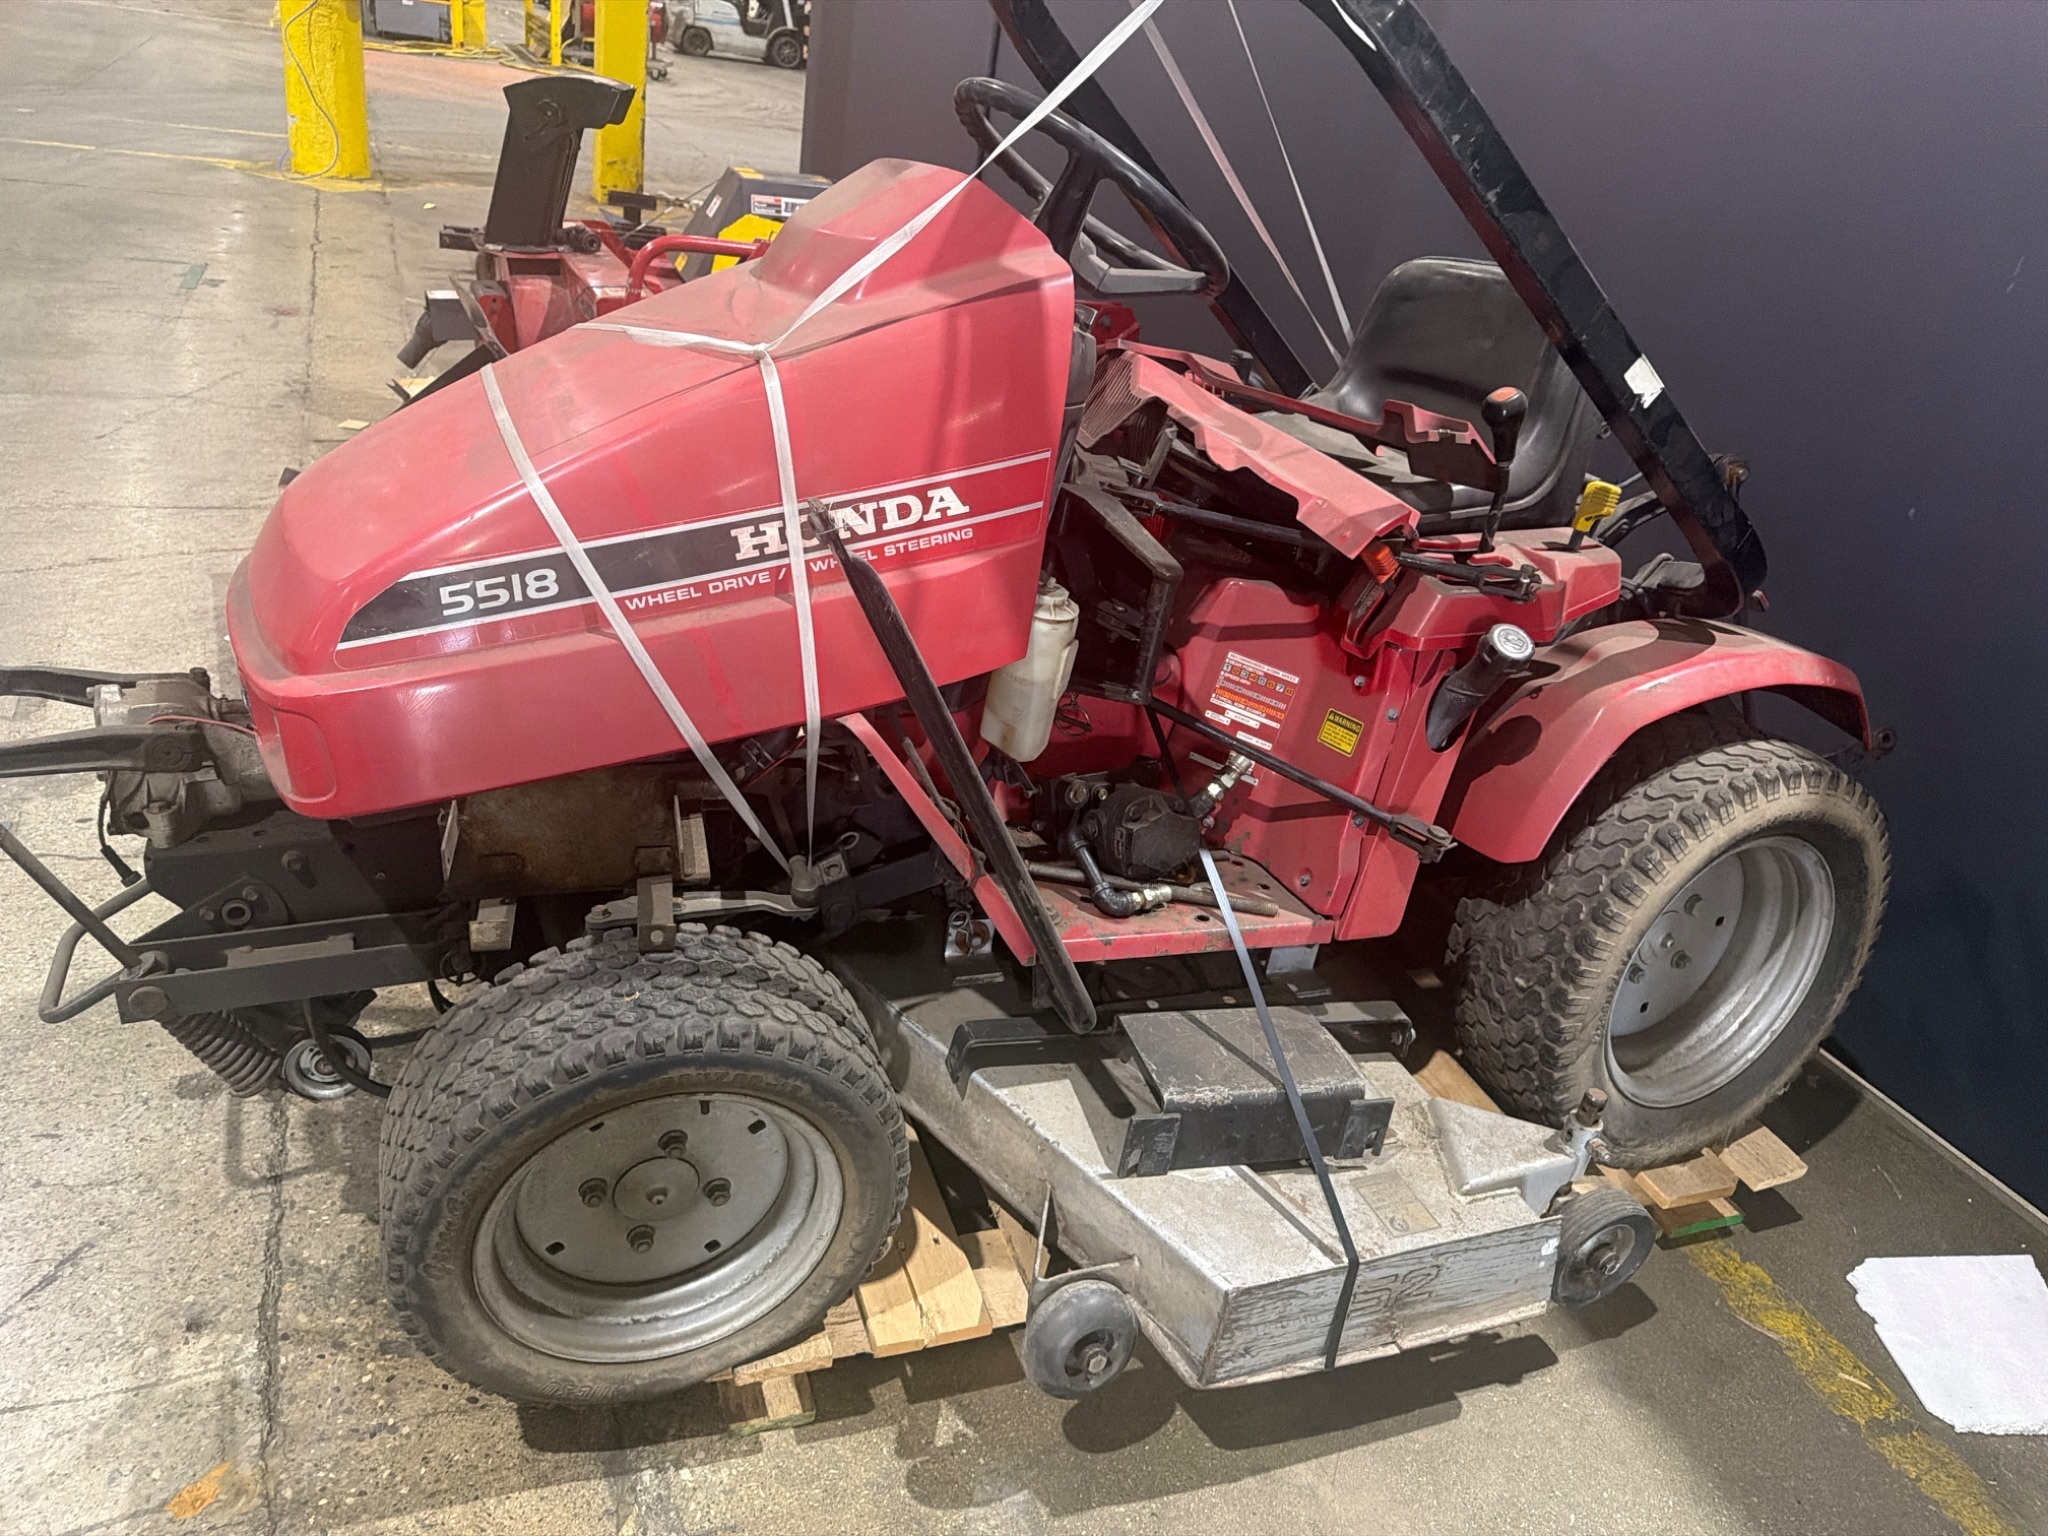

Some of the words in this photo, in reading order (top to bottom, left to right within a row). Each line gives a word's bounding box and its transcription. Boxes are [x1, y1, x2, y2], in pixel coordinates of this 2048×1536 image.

[439, 568, 560, 616] 5518
[625, 587, 702, 610] WHEEL
[708, 571, 771, 594] DRIVE
[777, 567, 787, 580] /
[810, 550, 878, 572] WHEL
[884, 528, 974, 557] STEERING
[1332, 714, 1361, 733] WARNING
